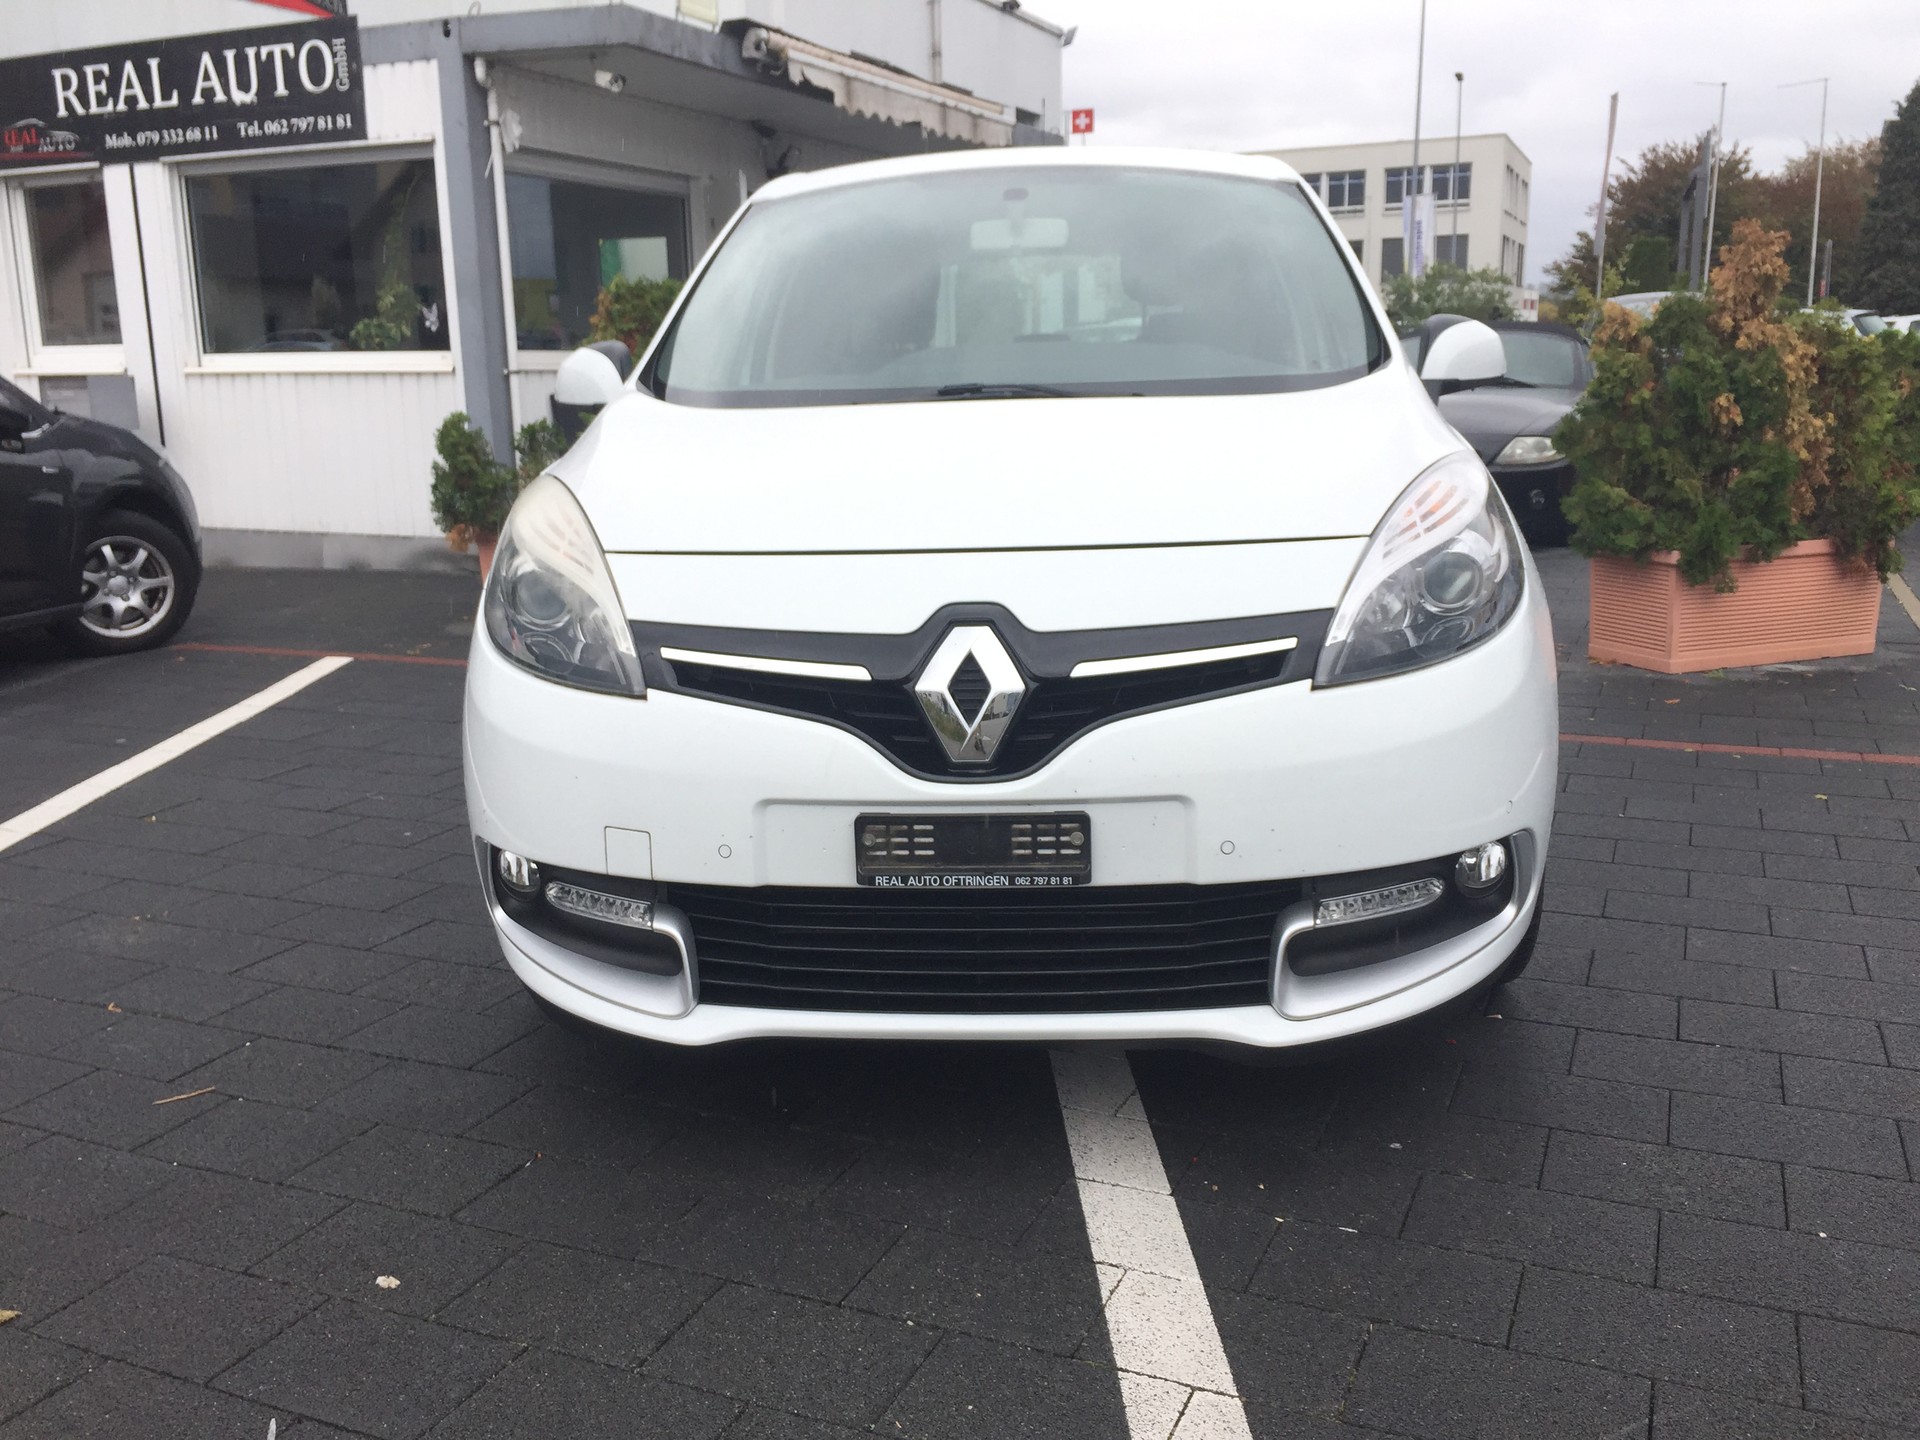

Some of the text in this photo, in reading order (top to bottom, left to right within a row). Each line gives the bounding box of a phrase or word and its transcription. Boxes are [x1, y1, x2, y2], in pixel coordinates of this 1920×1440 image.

[332, 38, 350, 92] GmbH
[51, 38, 334, 118] REAL AUTO
[204, 124, 218, 142] 11
[290, 116, 315, 134] 797
[317, 115, 333, 132] 81
[336, 112, 352, 130] 81
[875, 875, 1073, 887] REAL AUTO OFTRINGEN 062 797 81 81
